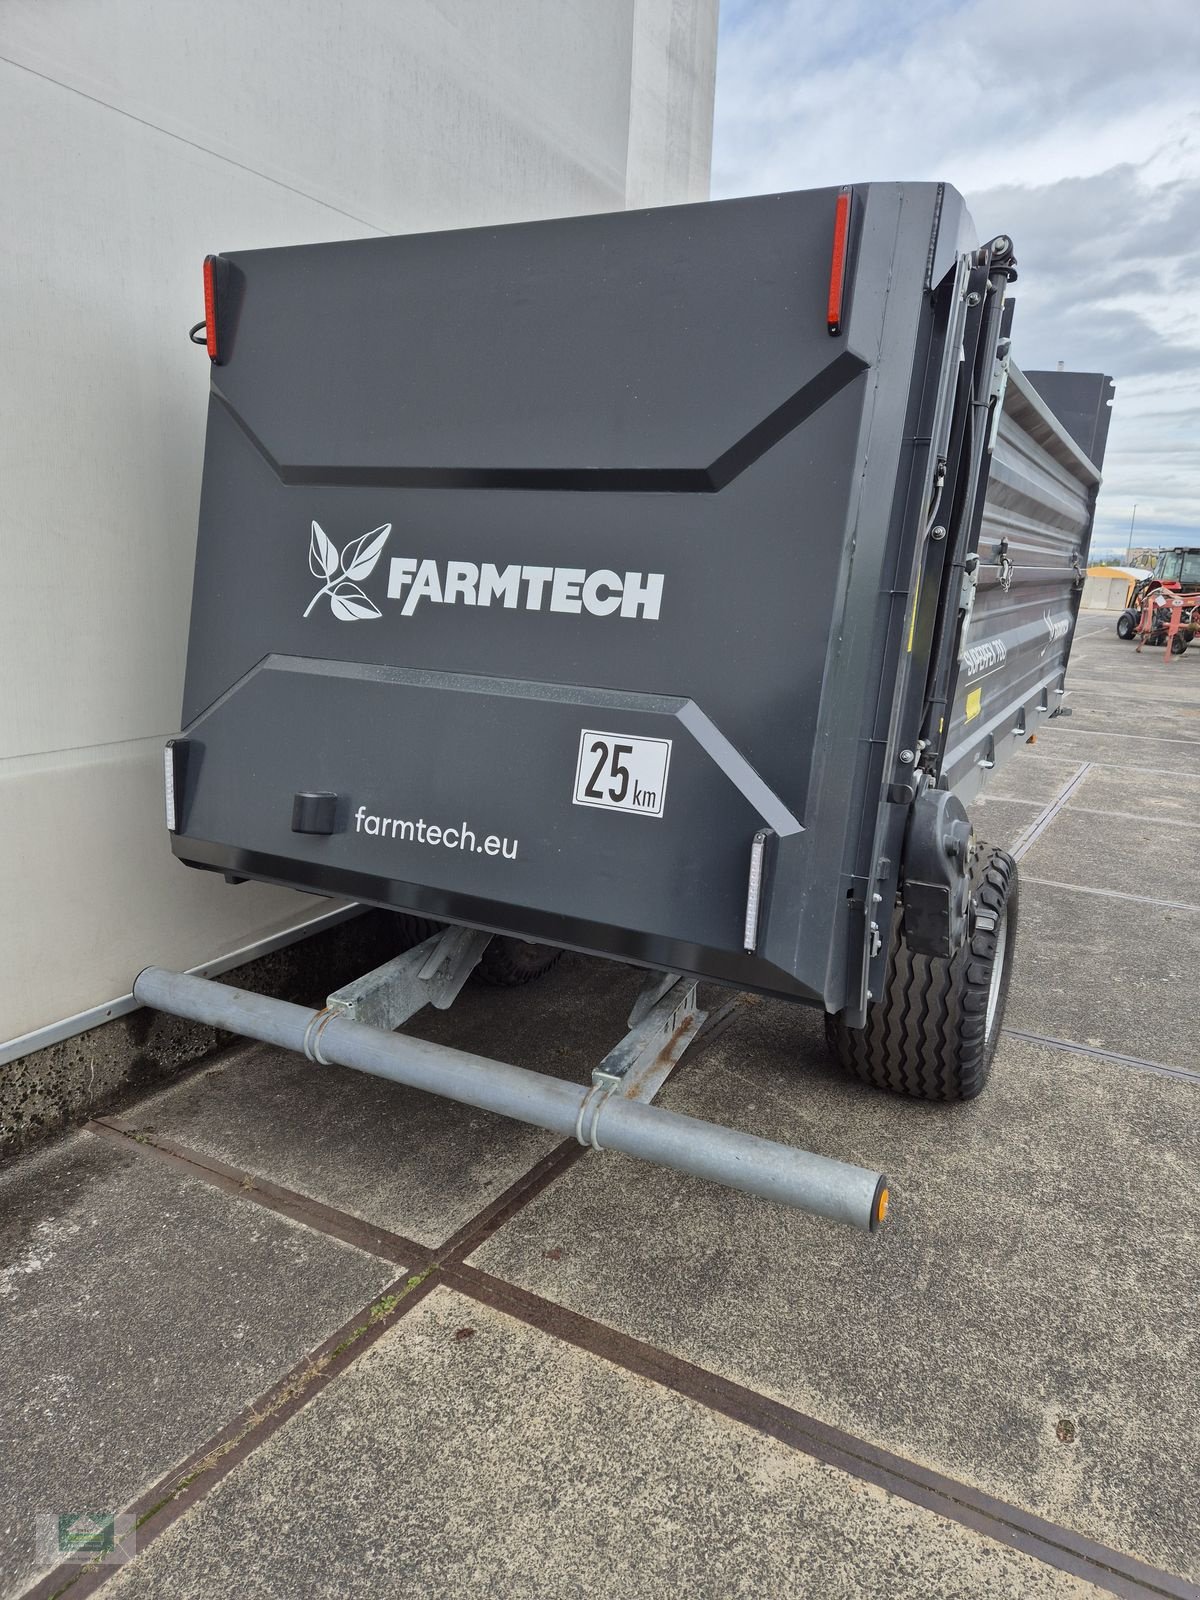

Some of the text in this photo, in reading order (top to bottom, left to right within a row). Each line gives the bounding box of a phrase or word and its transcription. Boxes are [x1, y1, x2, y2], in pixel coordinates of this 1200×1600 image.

[387, 557, 664, 620] FARMTECH
[584, 740, 656, 808] 25 km
[355, 806, 519, 859] farmtech.eu
